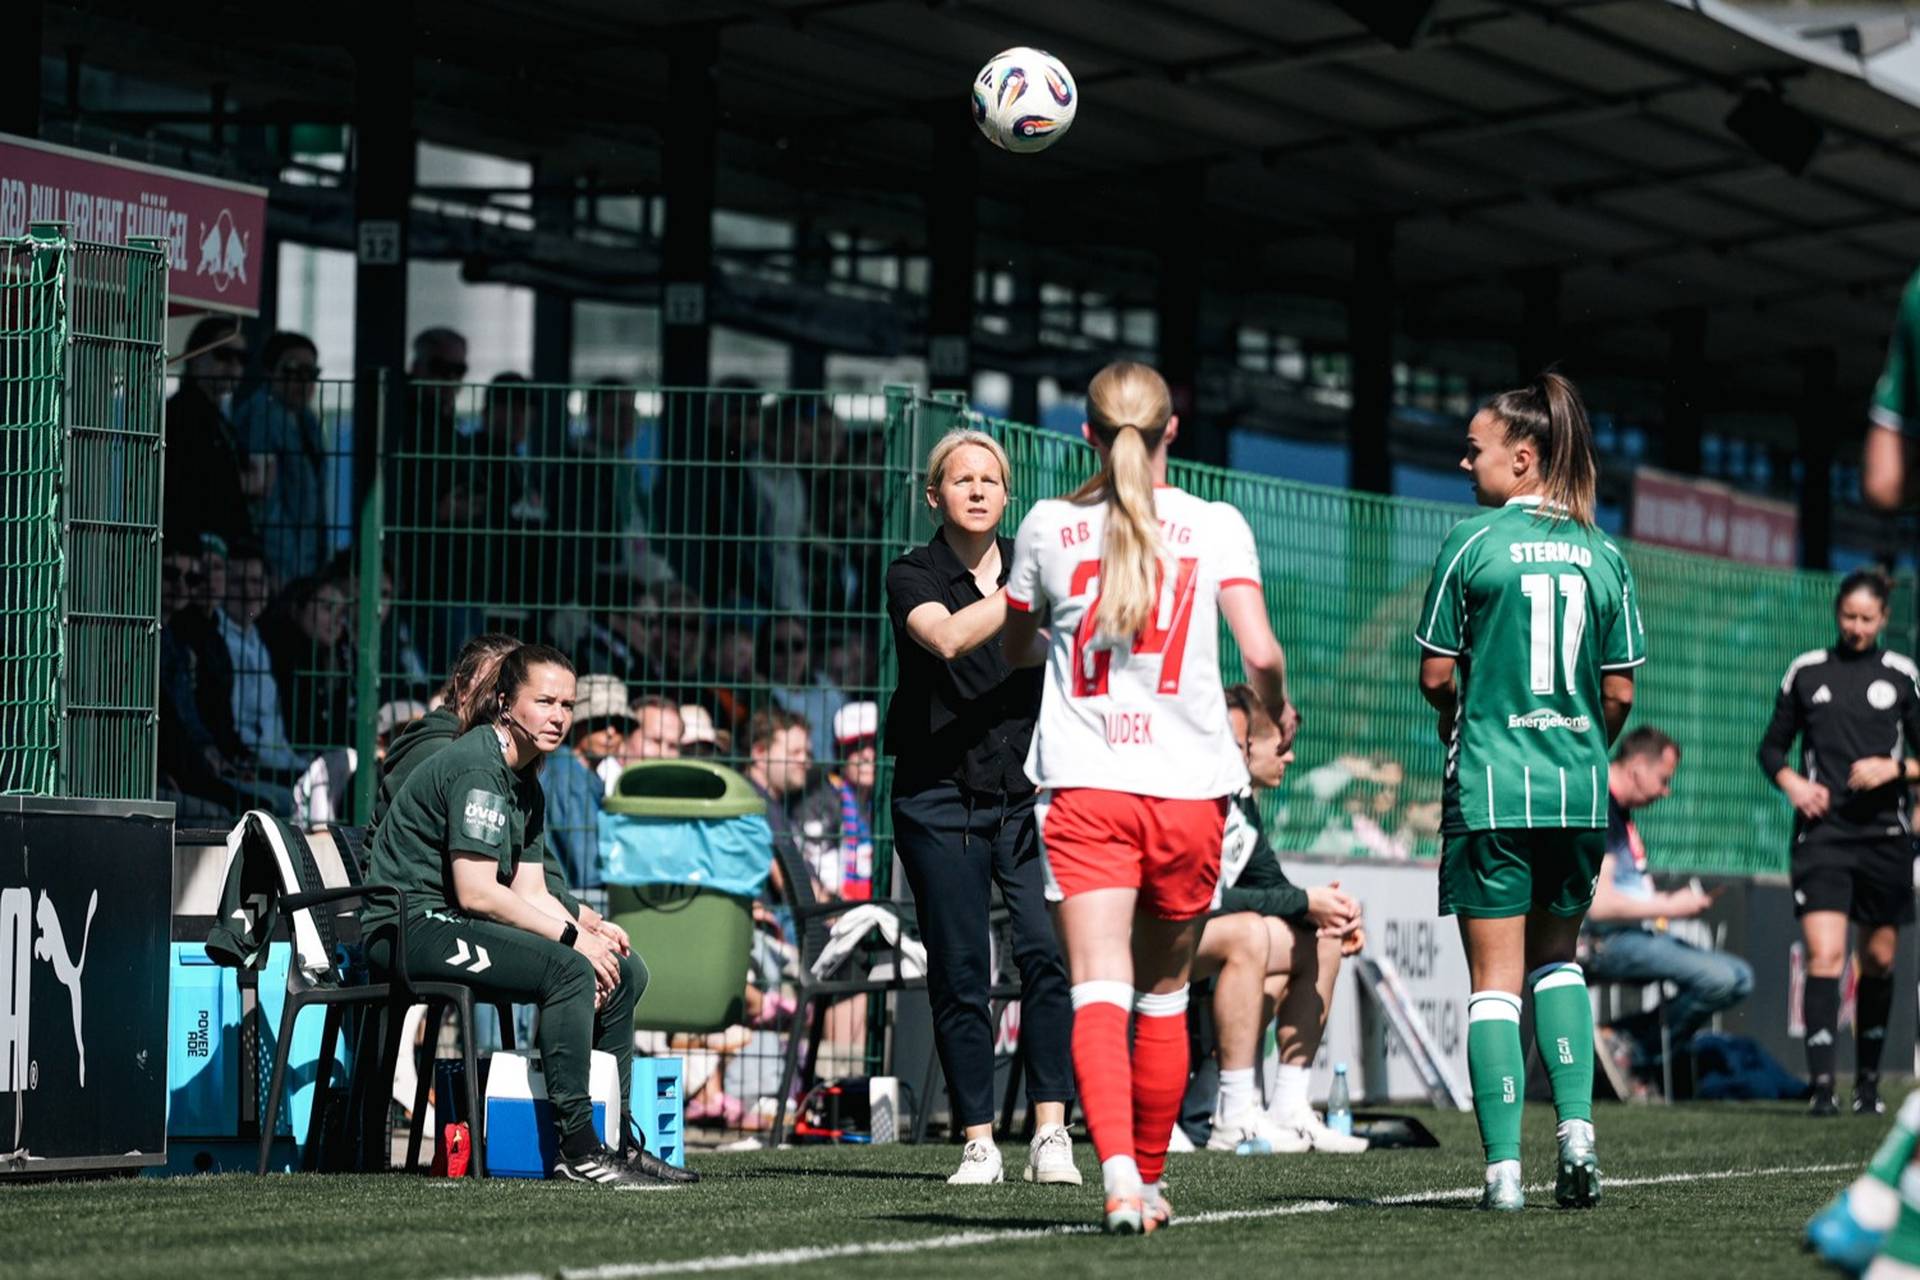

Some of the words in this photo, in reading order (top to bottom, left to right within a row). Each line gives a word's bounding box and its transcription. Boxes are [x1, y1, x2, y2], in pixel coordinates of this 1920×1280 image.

[0, 177, 27, 238] RED
[64, 189, 124, 247] VERLEIHT
[1060, 521, 1091, 548] RB
[1508, 541, 1593, 568] STERNAD
[1520, 573, 1588, 695] 11
[1105, 711, 1153, 745] UDEK
[187, 1031, 198, 1058] ADE
[198, 1010, 209, 1058] POWER
